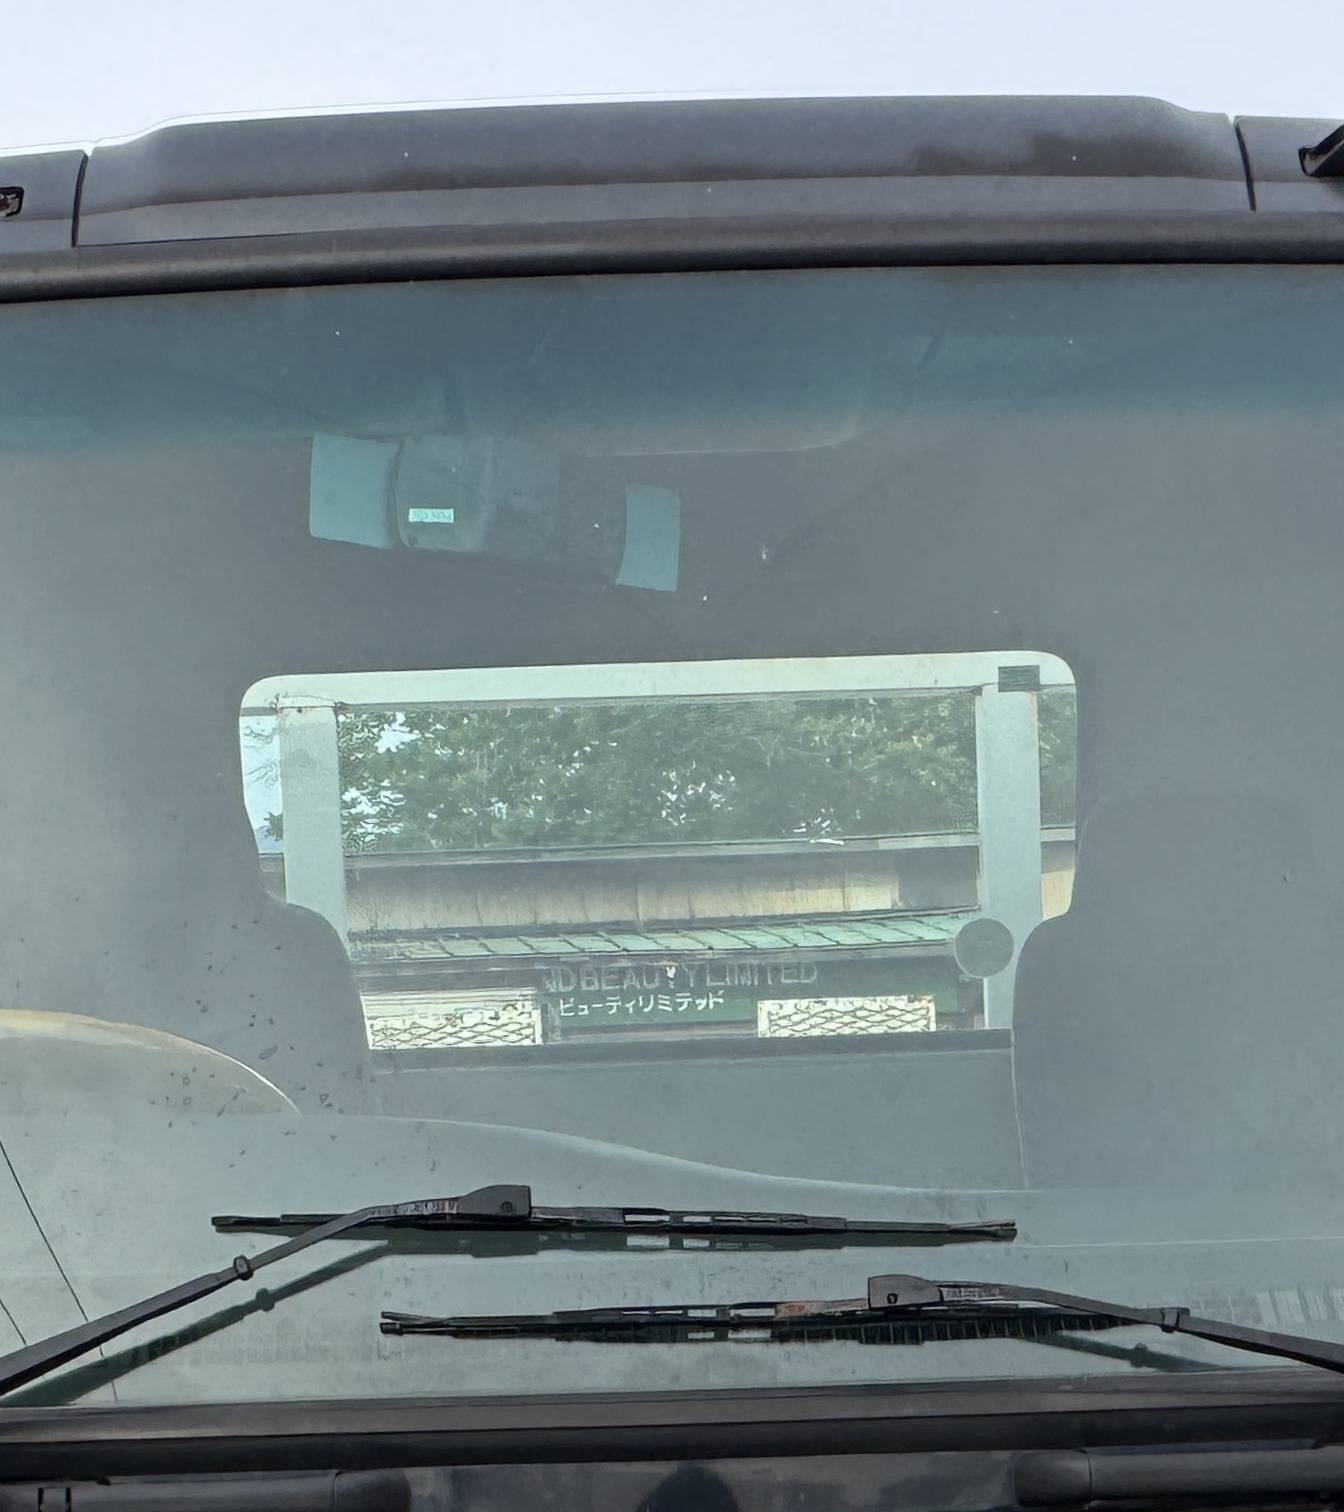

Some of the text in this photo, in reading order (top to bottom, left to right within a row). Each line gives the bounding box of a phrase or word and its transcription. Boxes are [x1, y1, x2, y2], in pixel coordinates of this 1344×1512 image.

[559, 990, 724, 1016] ビューティリミテッド
